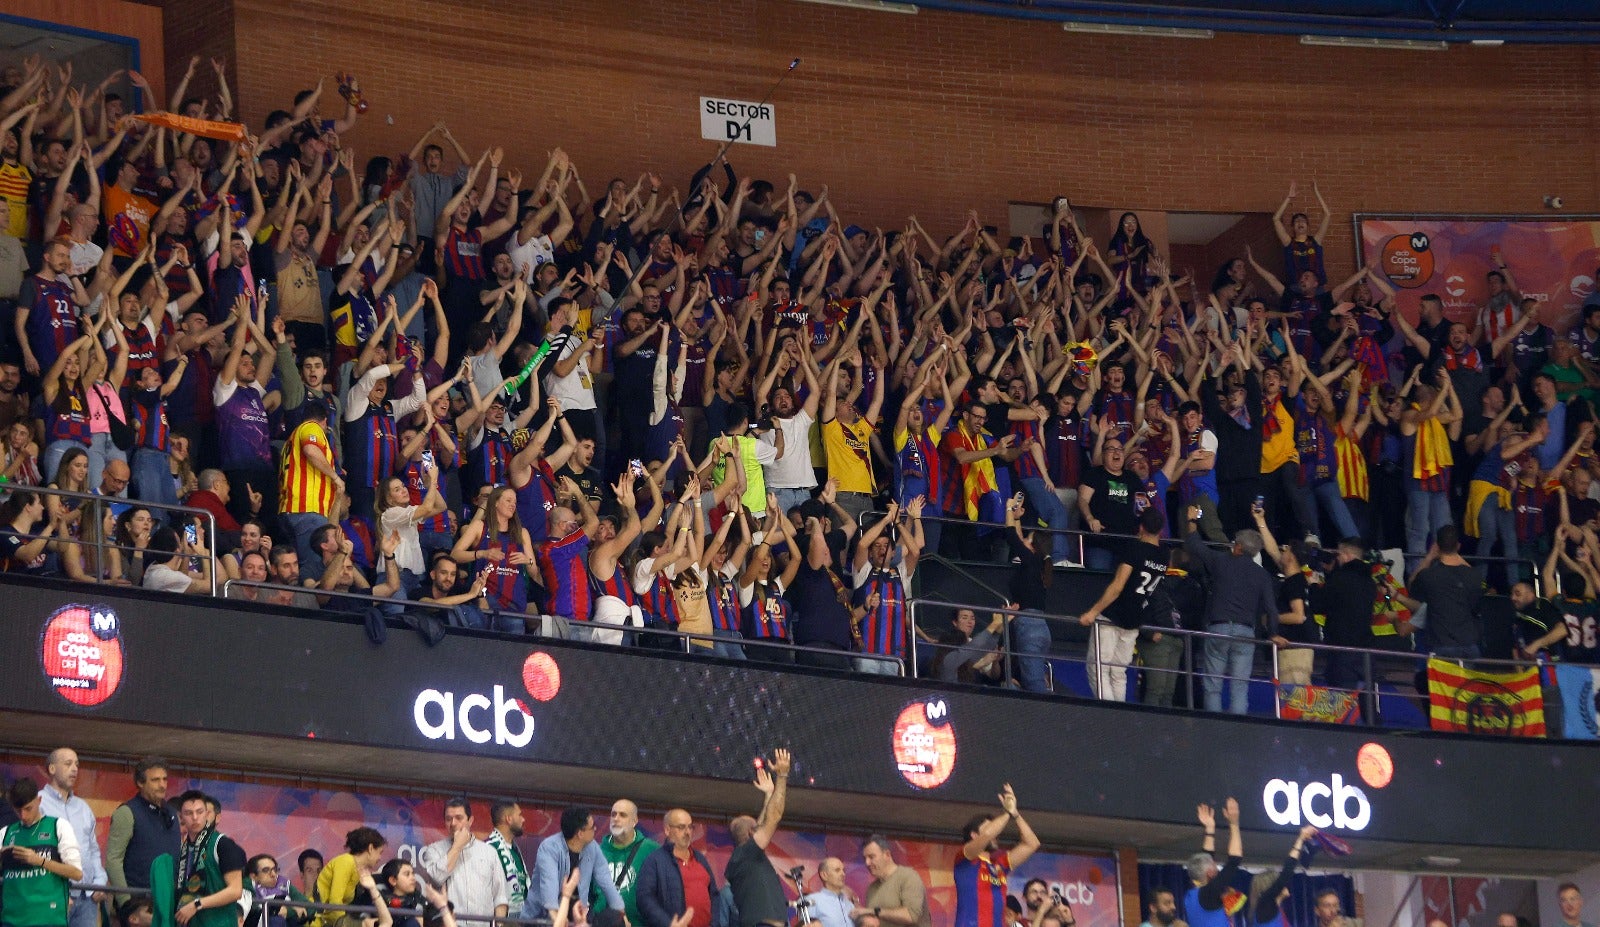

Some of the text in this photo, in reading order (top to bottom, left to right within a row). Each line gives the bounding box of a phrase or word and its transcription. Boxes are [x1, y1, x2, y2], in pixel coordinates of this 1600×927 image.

[705, 100, 770, 120] SECTOR
[726, 120, 752, 141] D1
[1390, 255, 1417, 266] Copa
[1403, 265, 1421, 275] Rey
[54, 299, 70, 314] 22
[765, 597, 781, 614] 46
[93, 612, 116, 631] M
[58, 640, 102, 662] Copa
[77, 659, 106, 681] Rey
[413, 684, 536, 748] acb
[926, 700, 948, 719] M
[1262, 773, 1372, 831] acb
[5, 868, 52, 880] JOVENTU
